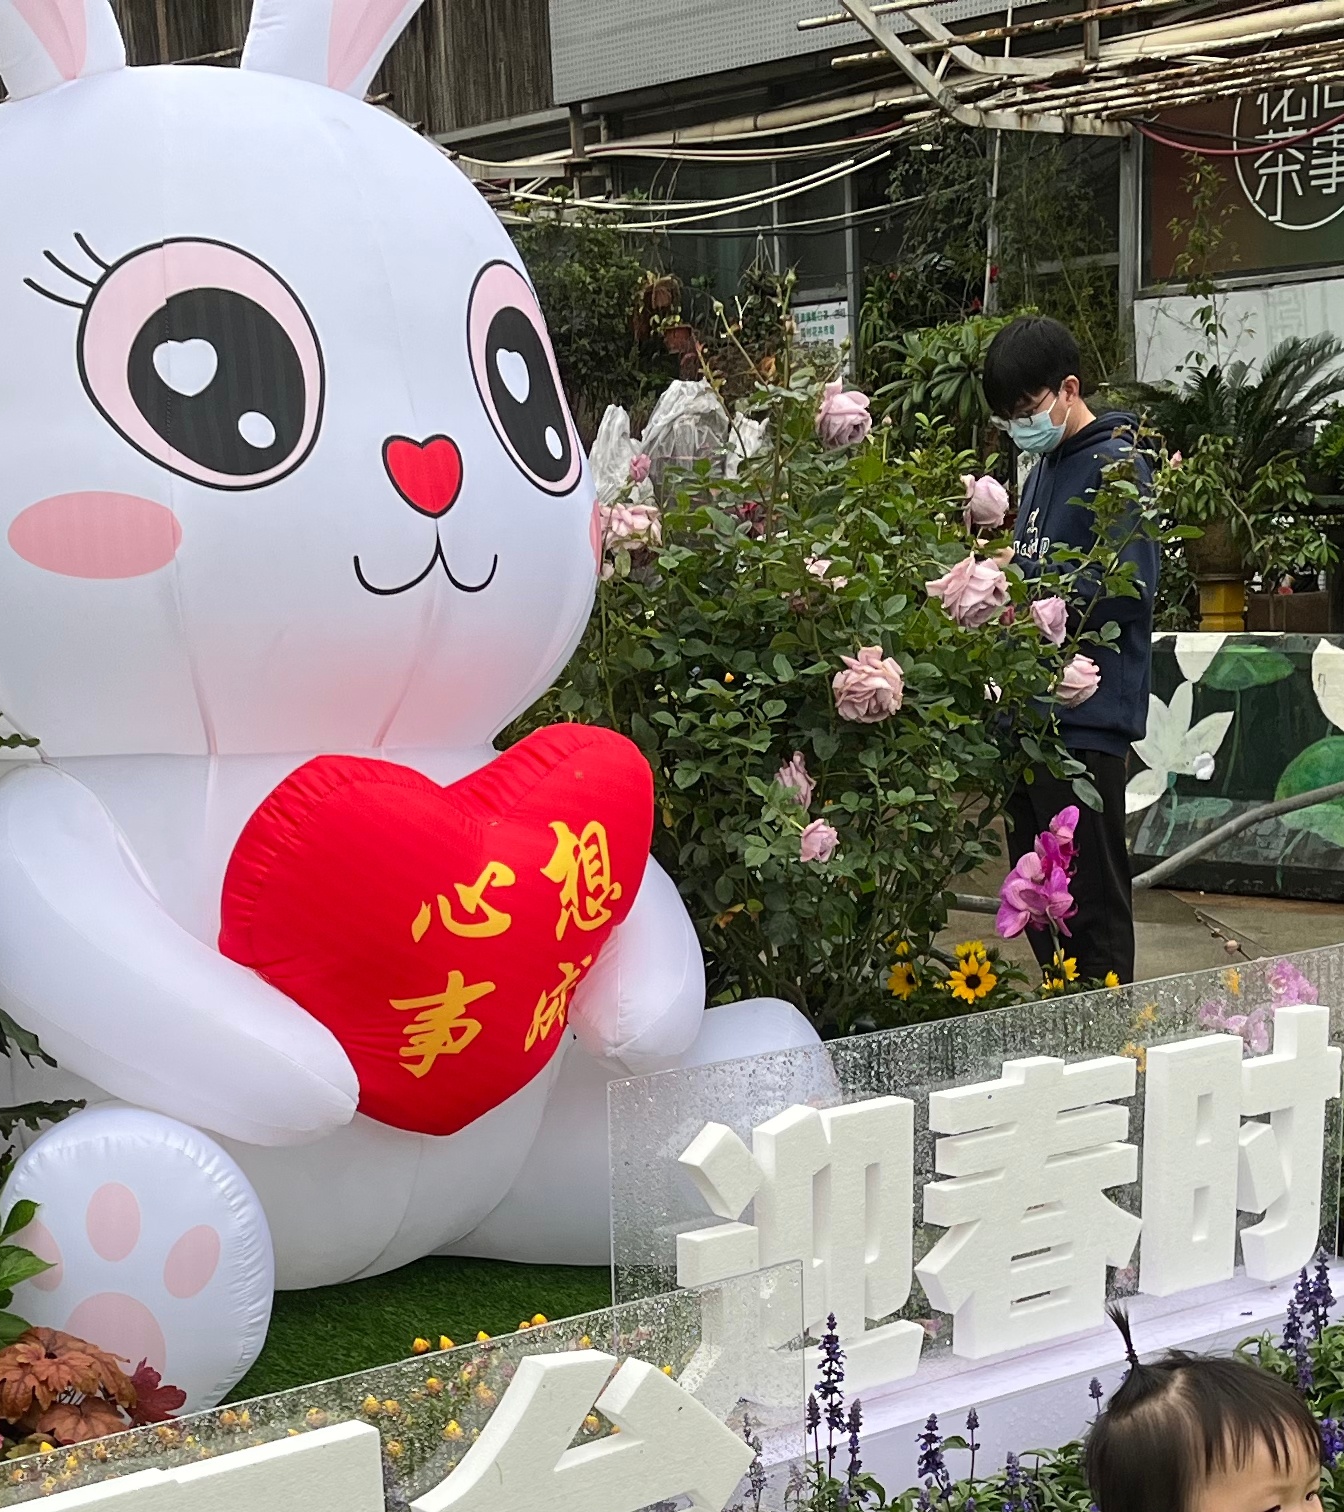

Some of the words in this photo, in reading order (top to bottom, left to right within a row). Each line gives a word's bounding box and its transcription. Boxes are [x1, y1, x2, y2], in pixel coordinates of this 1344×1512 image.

[411, 820, 623, 942] 心想
[677, 1004, 1342, 1405] 迎春时
